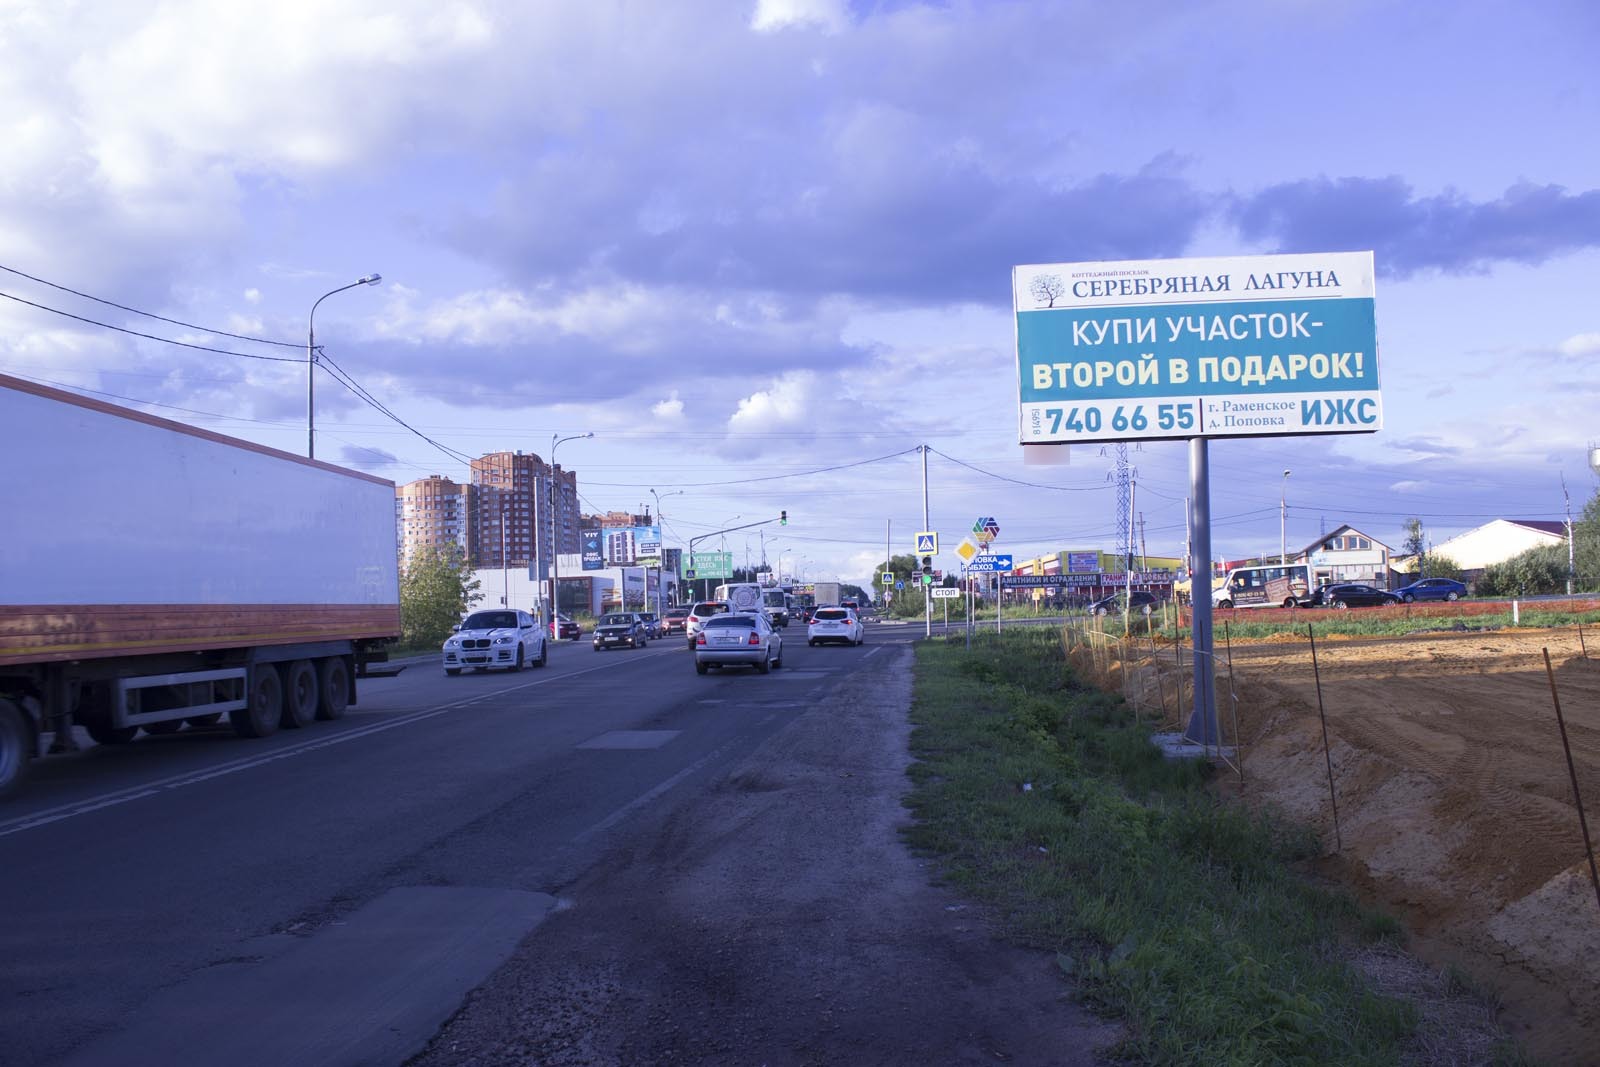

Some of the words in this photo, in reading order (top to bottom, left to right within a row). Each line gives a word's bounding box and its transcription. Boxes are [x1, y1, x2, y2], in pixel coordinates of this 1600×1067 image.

[1072, 274, 1231, 299] СЕРЕБРЯНАЯ
[1244, 270, 1342, 291] ЛАГУНА
[1072, 317, 1156, 346] КУПИ
[1167, 312, 1323, 343] УЧАСТОК-
[1032, 353, 1159, 390] ВТОРОЙ
[1168, 358, 1190, 384] В
[1199, 351, 1364, 387] ПОДАРОК!
[1045, 406, 1102, 434] 740
[1111, 405, 1148, 432] 66
[1158, 403, 1194, 429] 55
[1208, 404, 1219, 412] г.
[1222, 400, 1296, 412] Раменское
[1300, 397, 1377, 426] ИЖС
[1209, 419, 1220, 429] д.
[1224, 415, 1285, 427] Поповка
[935, 589, 956, 597] СТОП
[1001, 576, 1041, 584] АМЯТНИКИ
[1049, 574, 1097, 583] ОГРАЖДЕНИЯ
